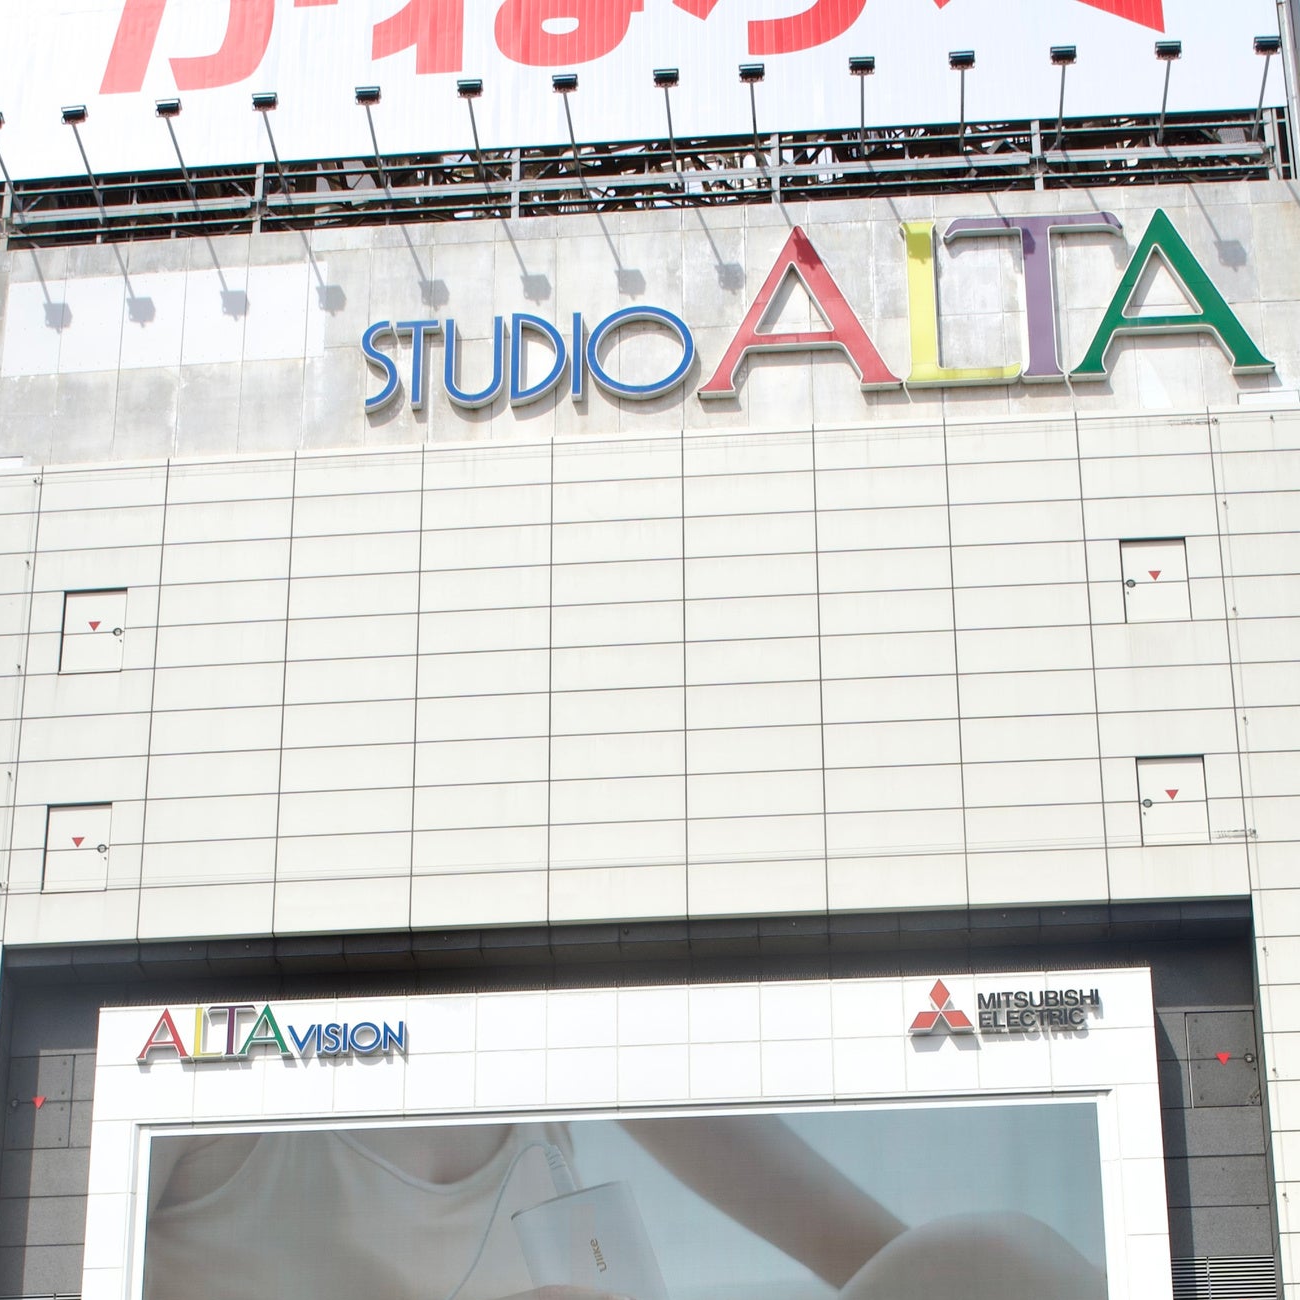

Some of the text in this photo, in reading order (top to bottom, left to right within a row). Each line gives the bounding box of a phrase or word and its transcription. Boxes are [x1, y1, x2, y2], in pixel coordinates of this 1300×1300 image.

[362, 207, 1277, 413] STUDIO ALTA
[978, 988, 1100, 1010] MITSUBISHI
[978, 1008, 1086, 1029] ELECTRIC
